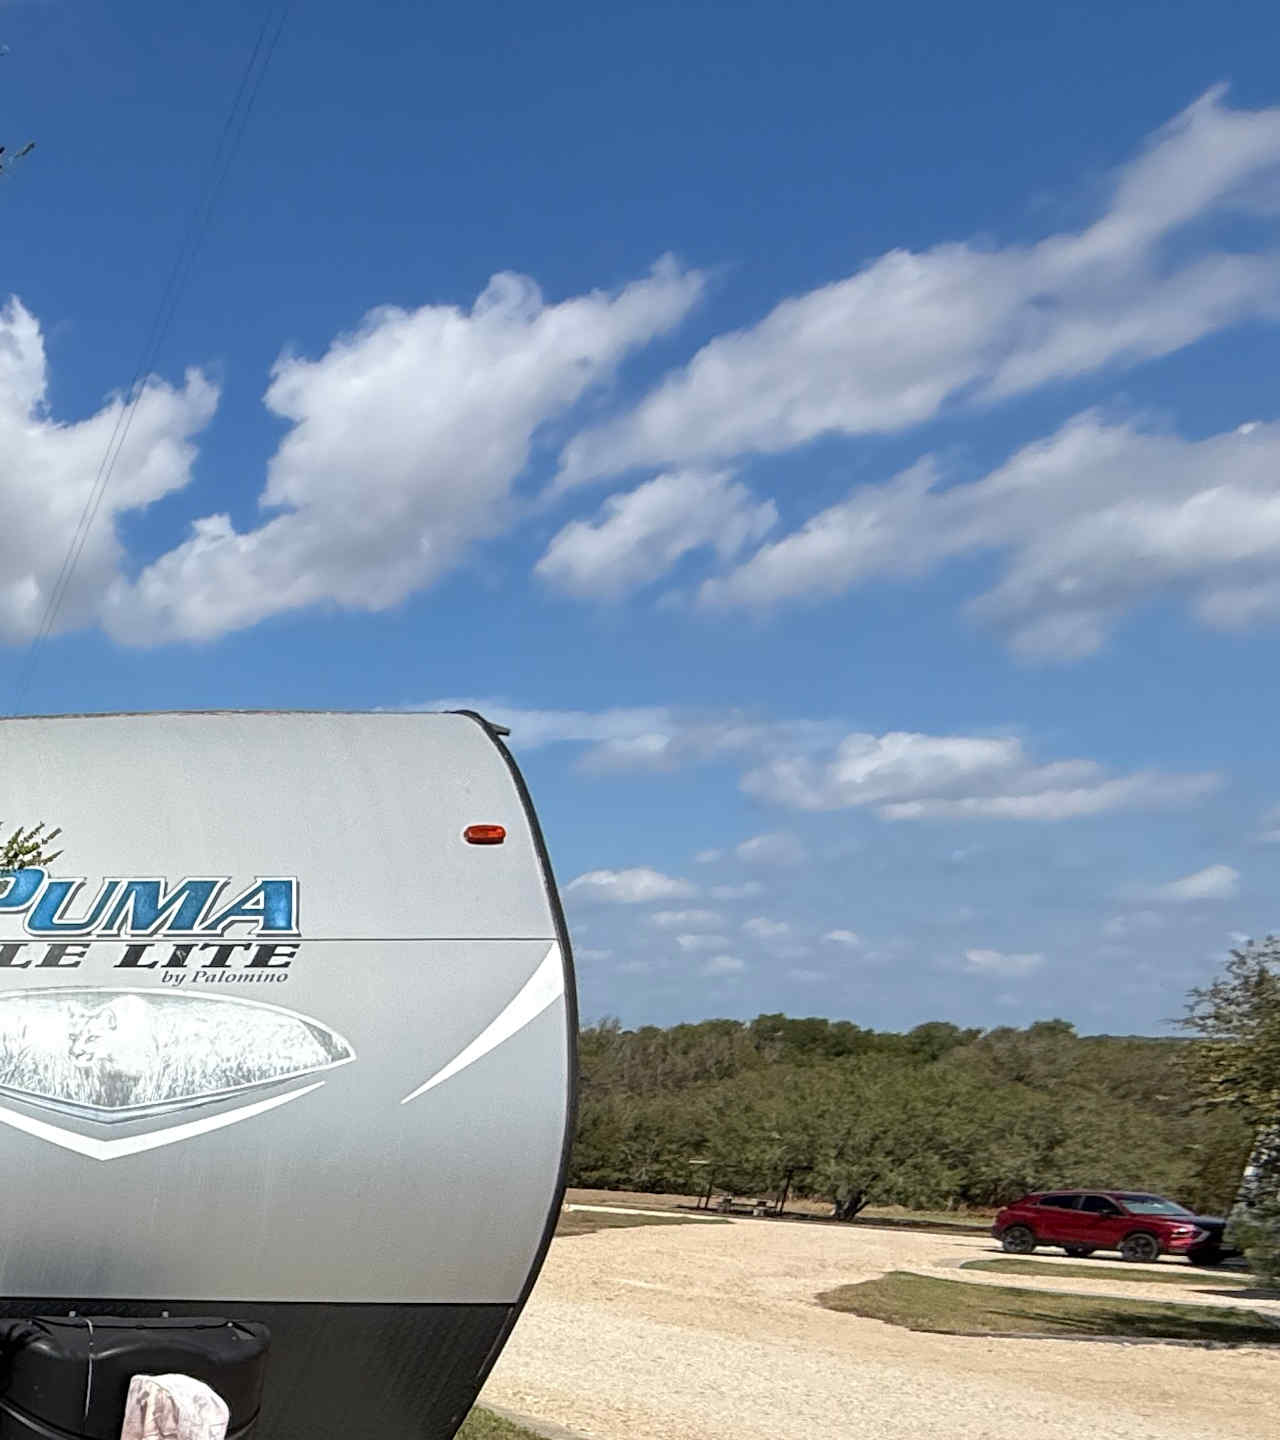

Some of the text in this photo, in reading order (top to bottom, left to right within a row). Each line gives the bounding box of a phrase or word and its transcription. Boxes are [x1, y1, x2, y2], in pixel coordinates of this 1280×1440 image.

[113, 943, 301, 969] LITE
[161, 970, 289, 987] by Palomino
